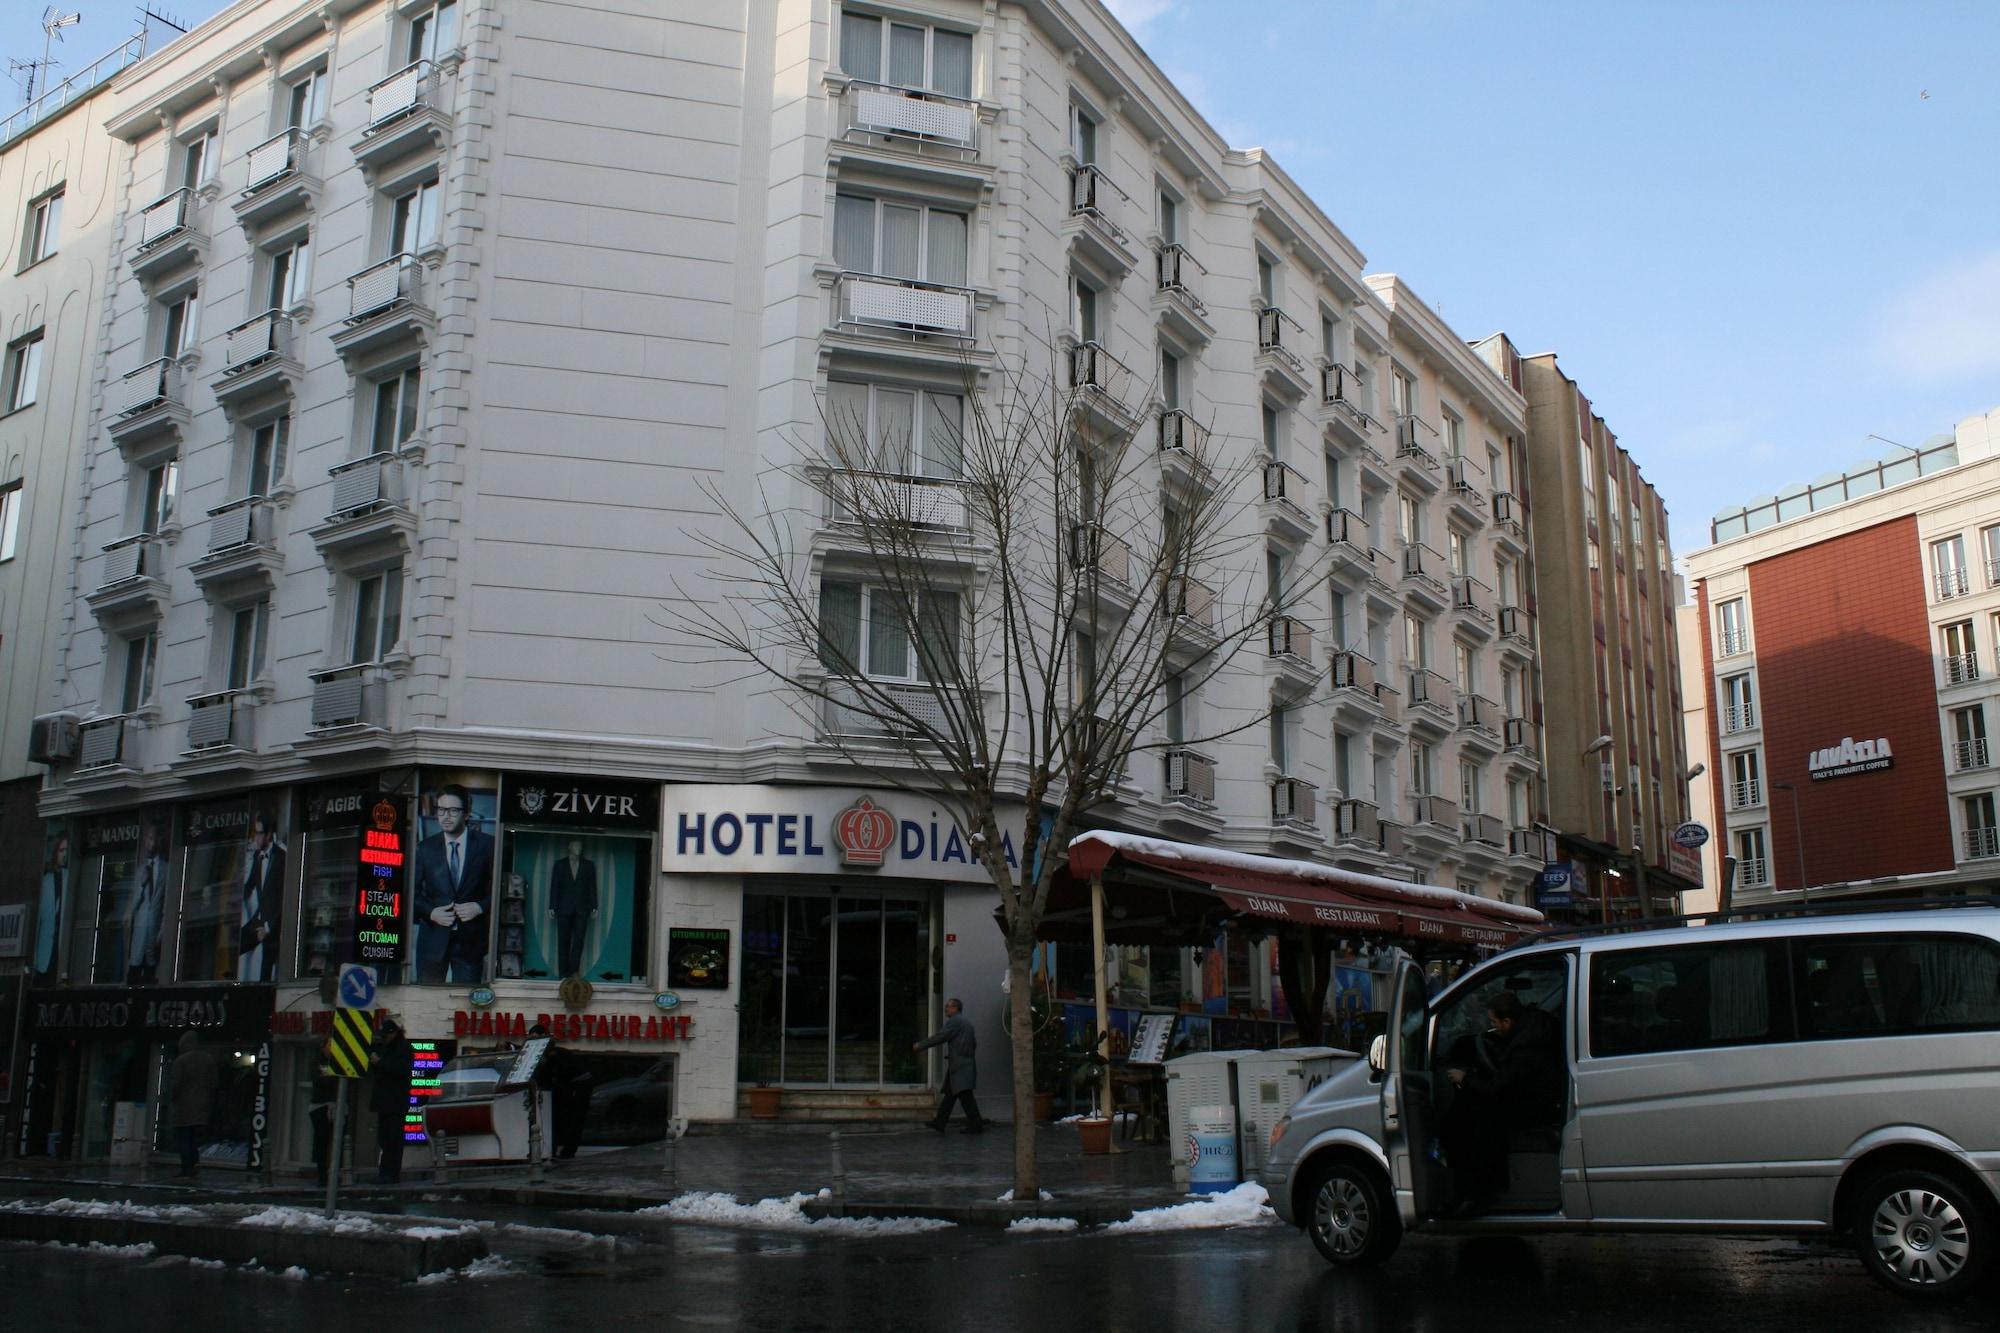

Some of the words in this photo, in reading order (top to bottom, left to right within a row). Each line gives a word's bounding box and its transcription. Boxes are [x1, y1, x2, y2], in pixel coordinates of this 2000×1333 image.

[1809, 737, 1893, 771] LAVAZZA
[1813, 770, 1834, 780] ITALY'S
[1834, 764, 1866, 776] FAVOURITE
[1866, 759, 1890, 771] COFFEE
[366, 830, 400, 850] DIANA
[677, 811, 825, 856] HOTEL
[901, 811, 1018, 869] DİAA
[373, 865, 393, 878] FISH
[1543, 872, 1565, 882] EFES
[377, 879, 386, 891] &
[367, 891, 394, 903] STEAK
[366, 904, 394, 917] LOCAL
[1314, 907, 1381, 925] RESTAURANT
[376, 918, 384, 930] &
[359, 931, 398, 945] OTTOMAN
[1461, 927, 1507, 942] RESTAURANT
[362, 945, 394, 959] CUISINE
[37, 1001, 130, 1028] MANSO
[453, 1010, 526, 1037] DIANA
[537, 1013, 692, 1041] RESTAURANT
